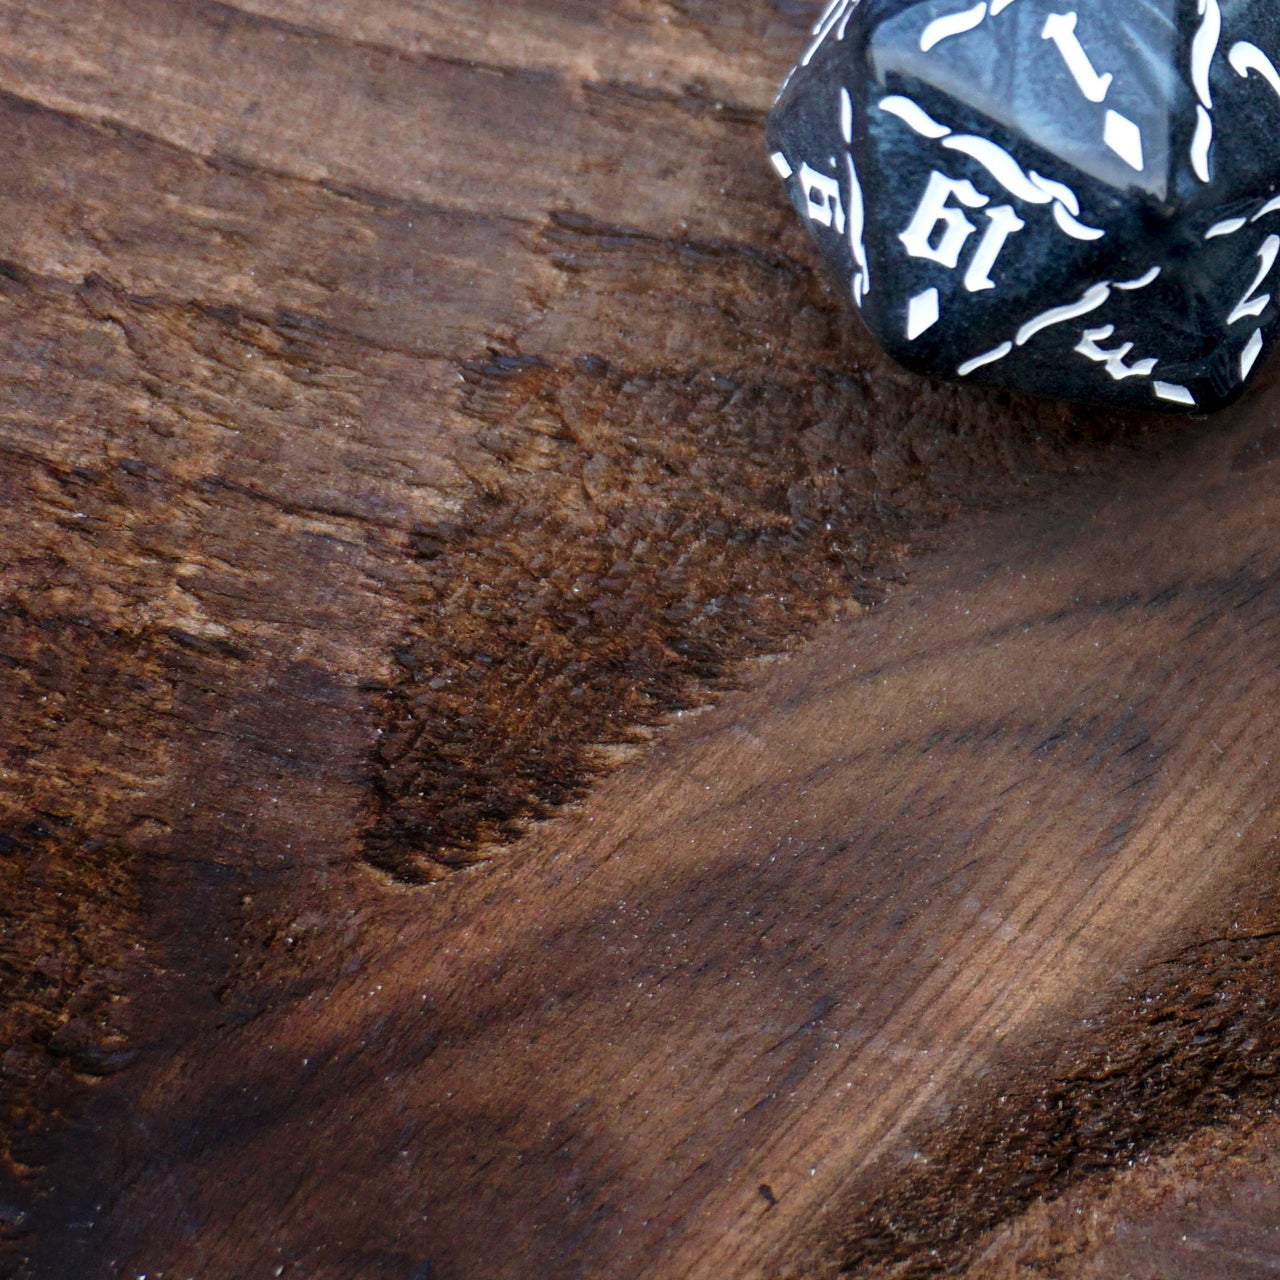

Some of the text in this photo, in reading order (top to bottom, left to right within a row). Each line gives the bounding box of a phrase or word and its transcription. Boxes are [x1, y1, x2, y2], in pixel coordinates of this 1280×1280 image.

[1041, 11, 1113, 103] 1
[897, 170, 1025, 293] 19
[1074, 324, 1158, 381] 3
